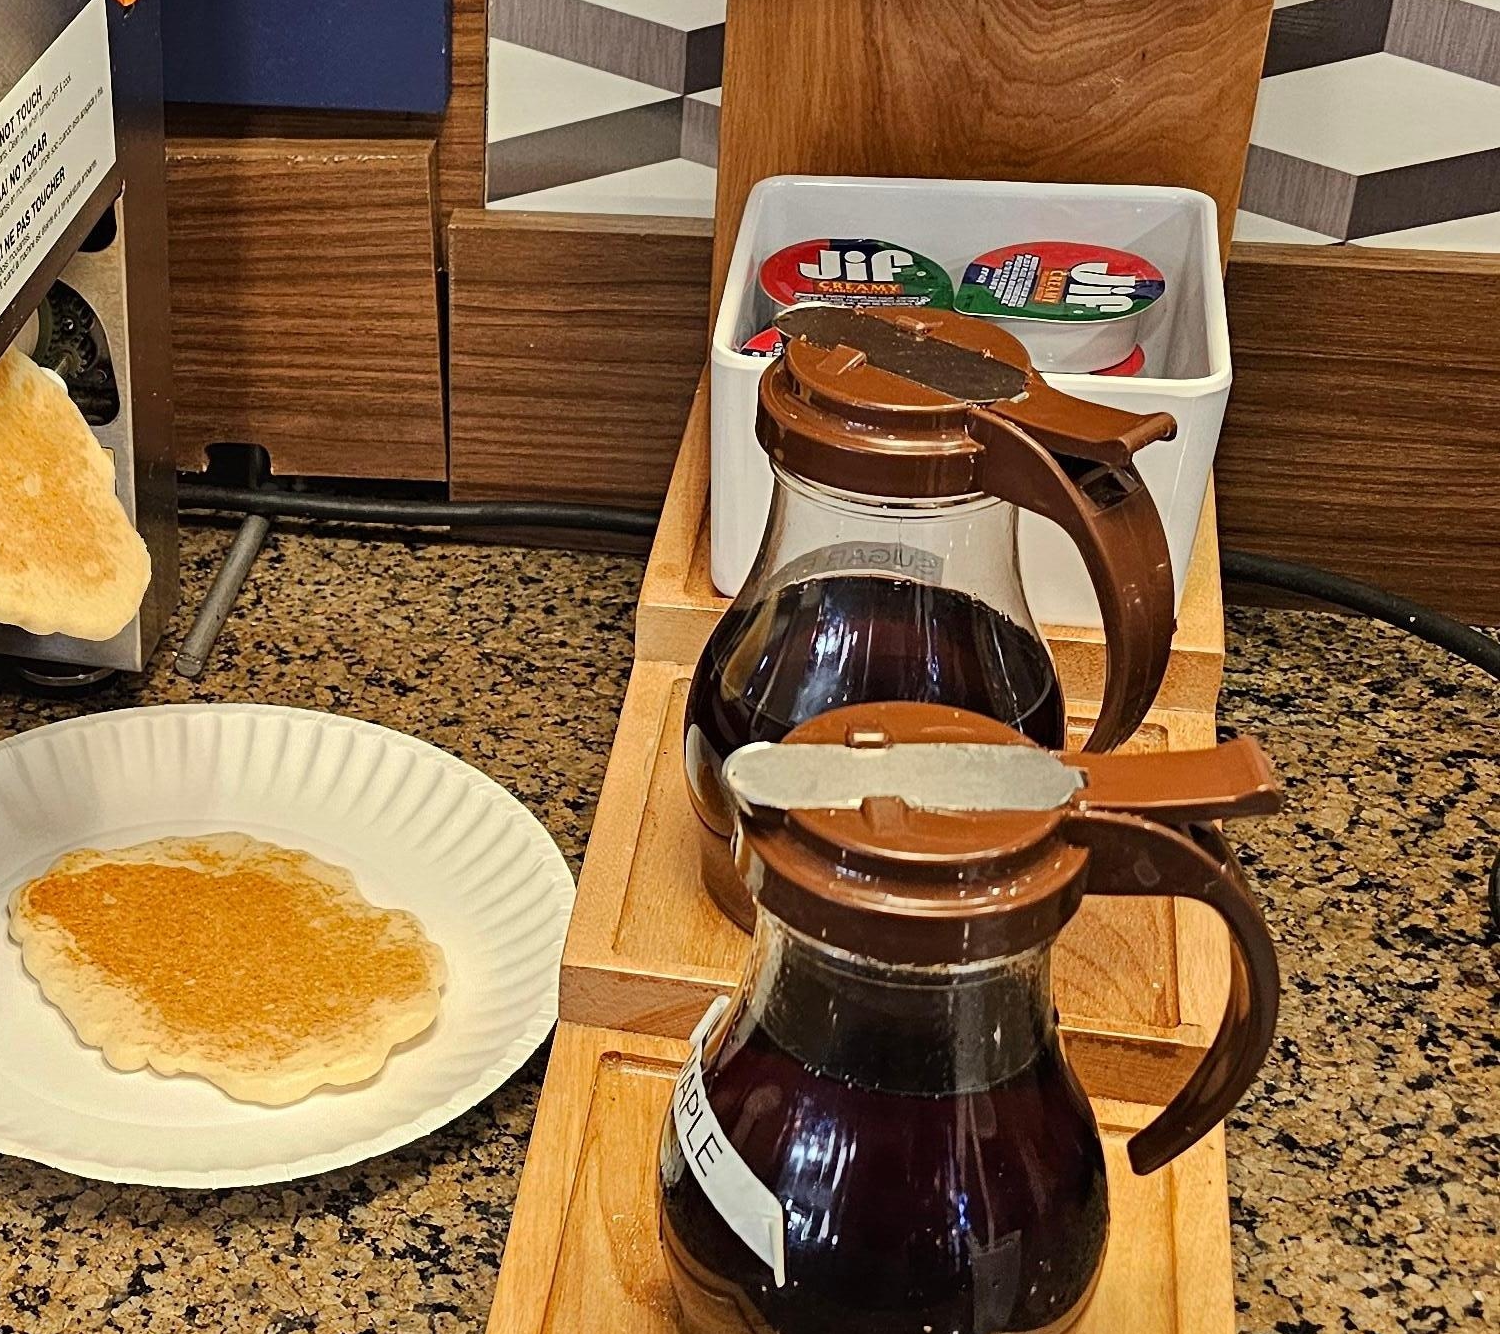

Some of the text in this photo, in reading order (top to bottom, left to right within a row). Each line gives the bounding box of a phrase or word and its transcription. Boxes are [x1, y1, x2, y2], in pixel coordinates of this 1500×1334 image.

[15, 83, 42, 128] TOUCH
[9, 161, 21, 190] NO
[21, 129, 47, 175] TOCAR
[3, 226, 15, 255] NE
[15, 207, 30, 239] PAS
[30, 163, 65, 220] TOUCHER
[799, 249, 915, 283] Jif
[818, 281, 900, 292] CREAMY
[1040, 269, 1074, 304] CREAMY
[1066, 262, 1138, 313] Jif
